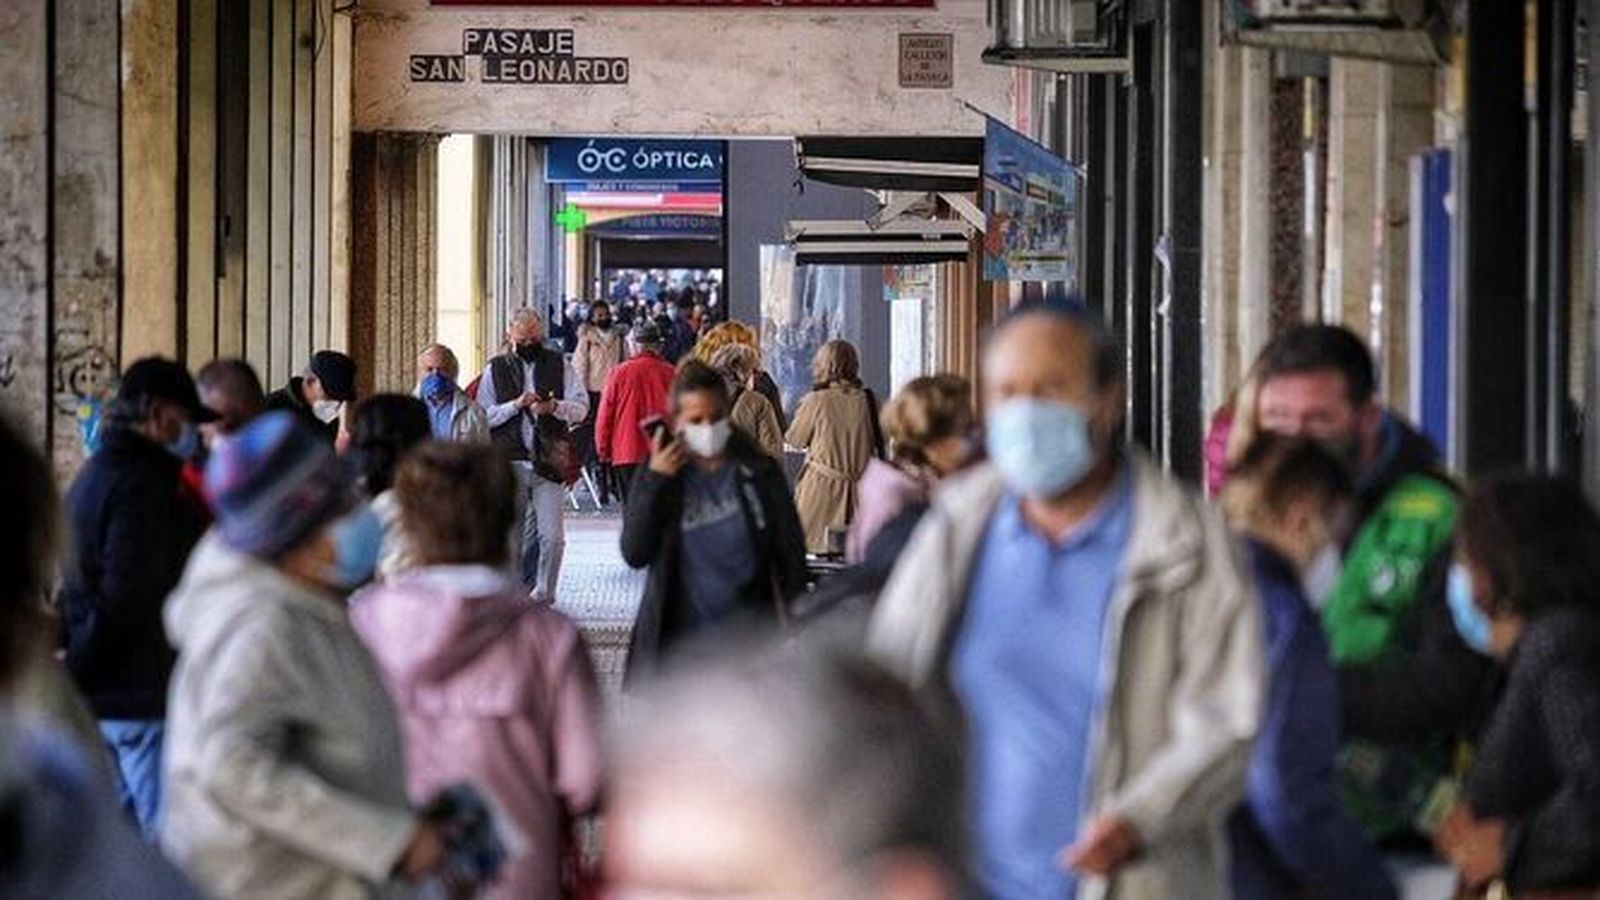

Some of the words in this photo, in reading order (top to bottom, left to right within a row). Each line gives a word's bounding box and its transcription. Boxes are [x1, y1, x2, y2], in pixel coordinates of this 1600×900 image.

[464, 31, 573, 54] PASAJE
[411, 57, 465, 80] SAN
[482, 58, 628, 82] LEONARDO
[632, 146, 714, 168] ÓPTICA
